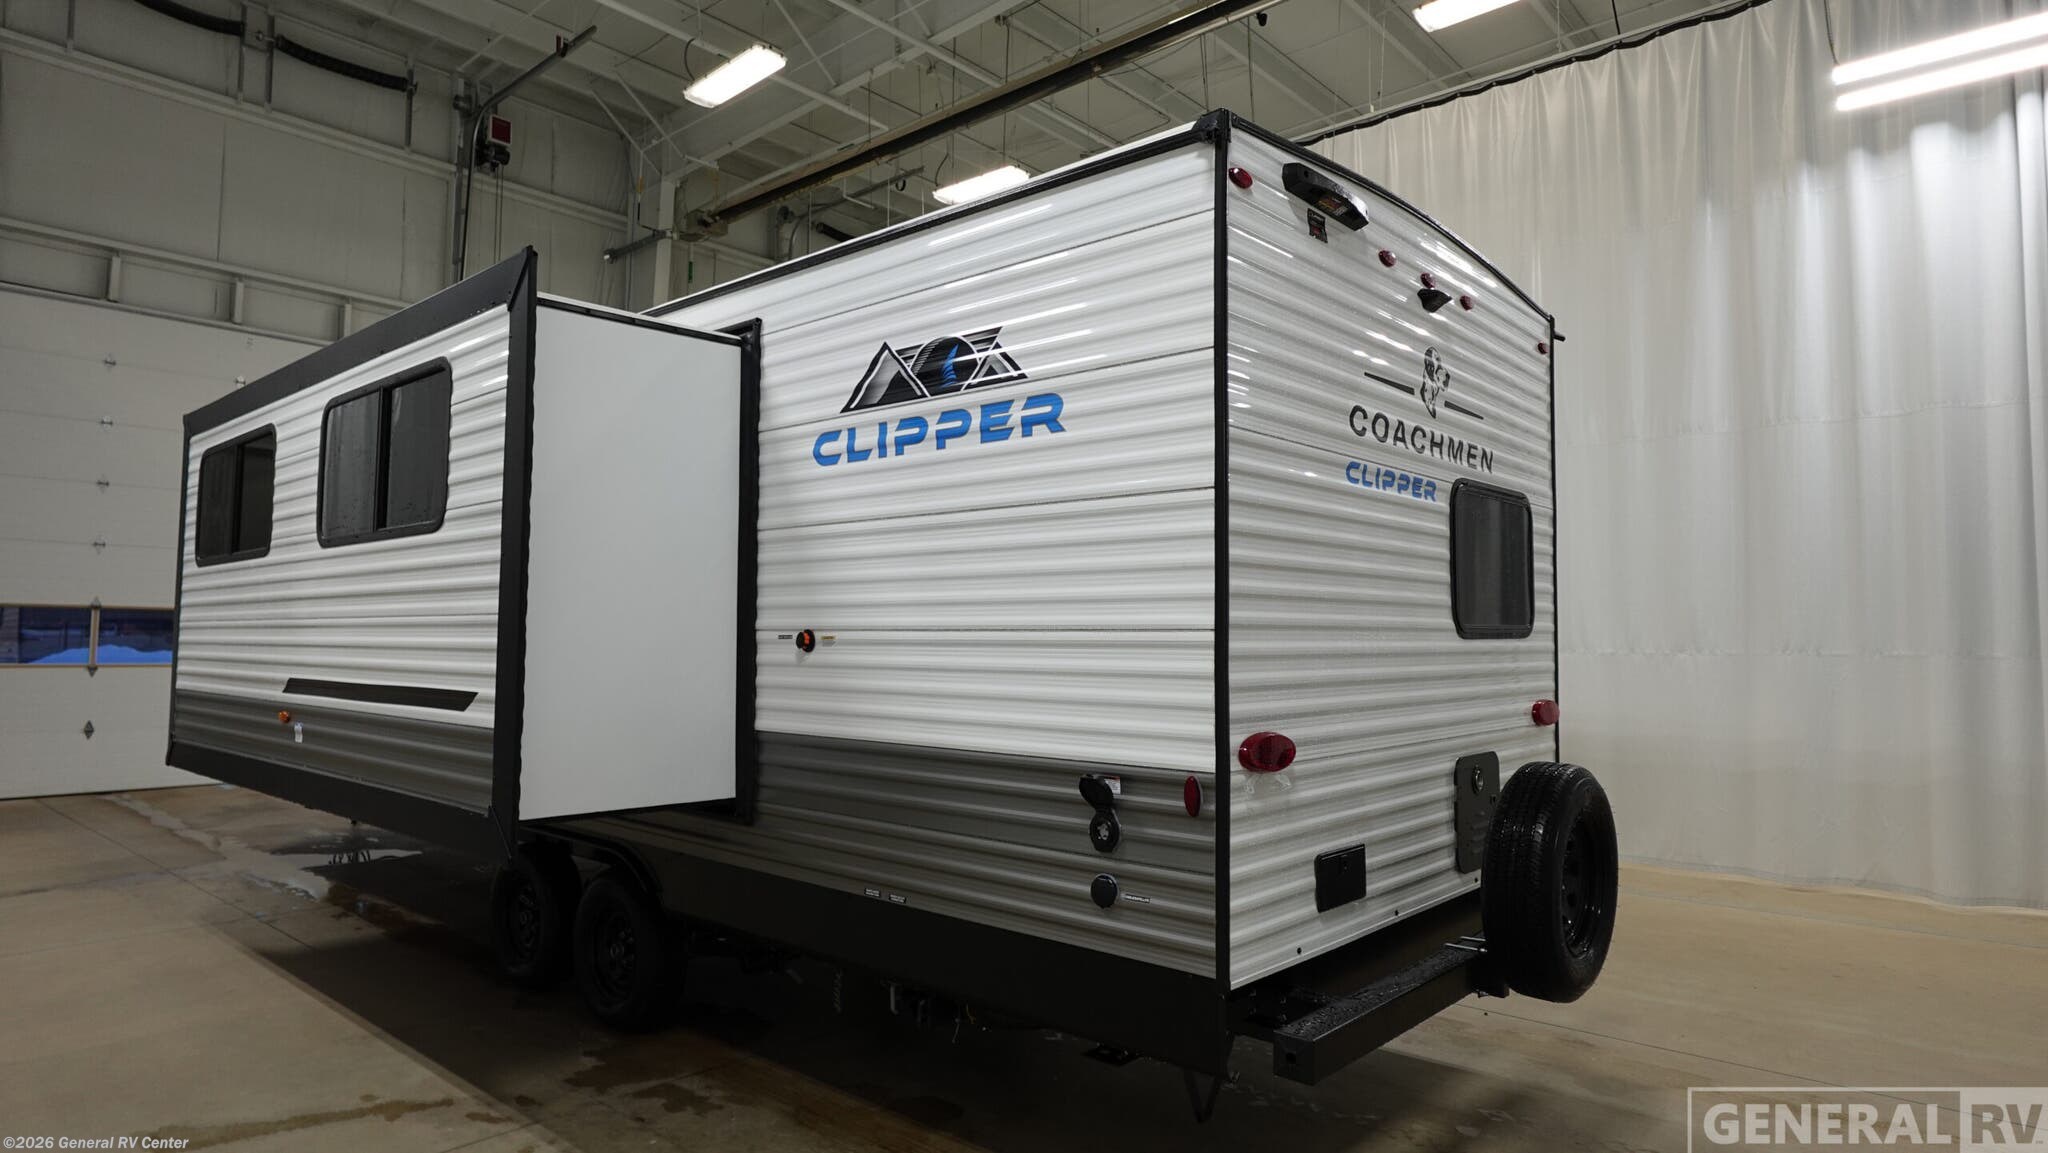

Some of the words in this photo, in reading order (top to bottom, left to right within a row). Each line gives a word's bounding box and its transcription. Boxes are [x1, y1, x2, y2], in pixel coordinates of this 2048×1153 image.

[813, 393, 1066, 467] CLIPPER
[1349, 405, 1494, 474] COACHMEN
[1345, 461, 1438, 502] CLIPPER
